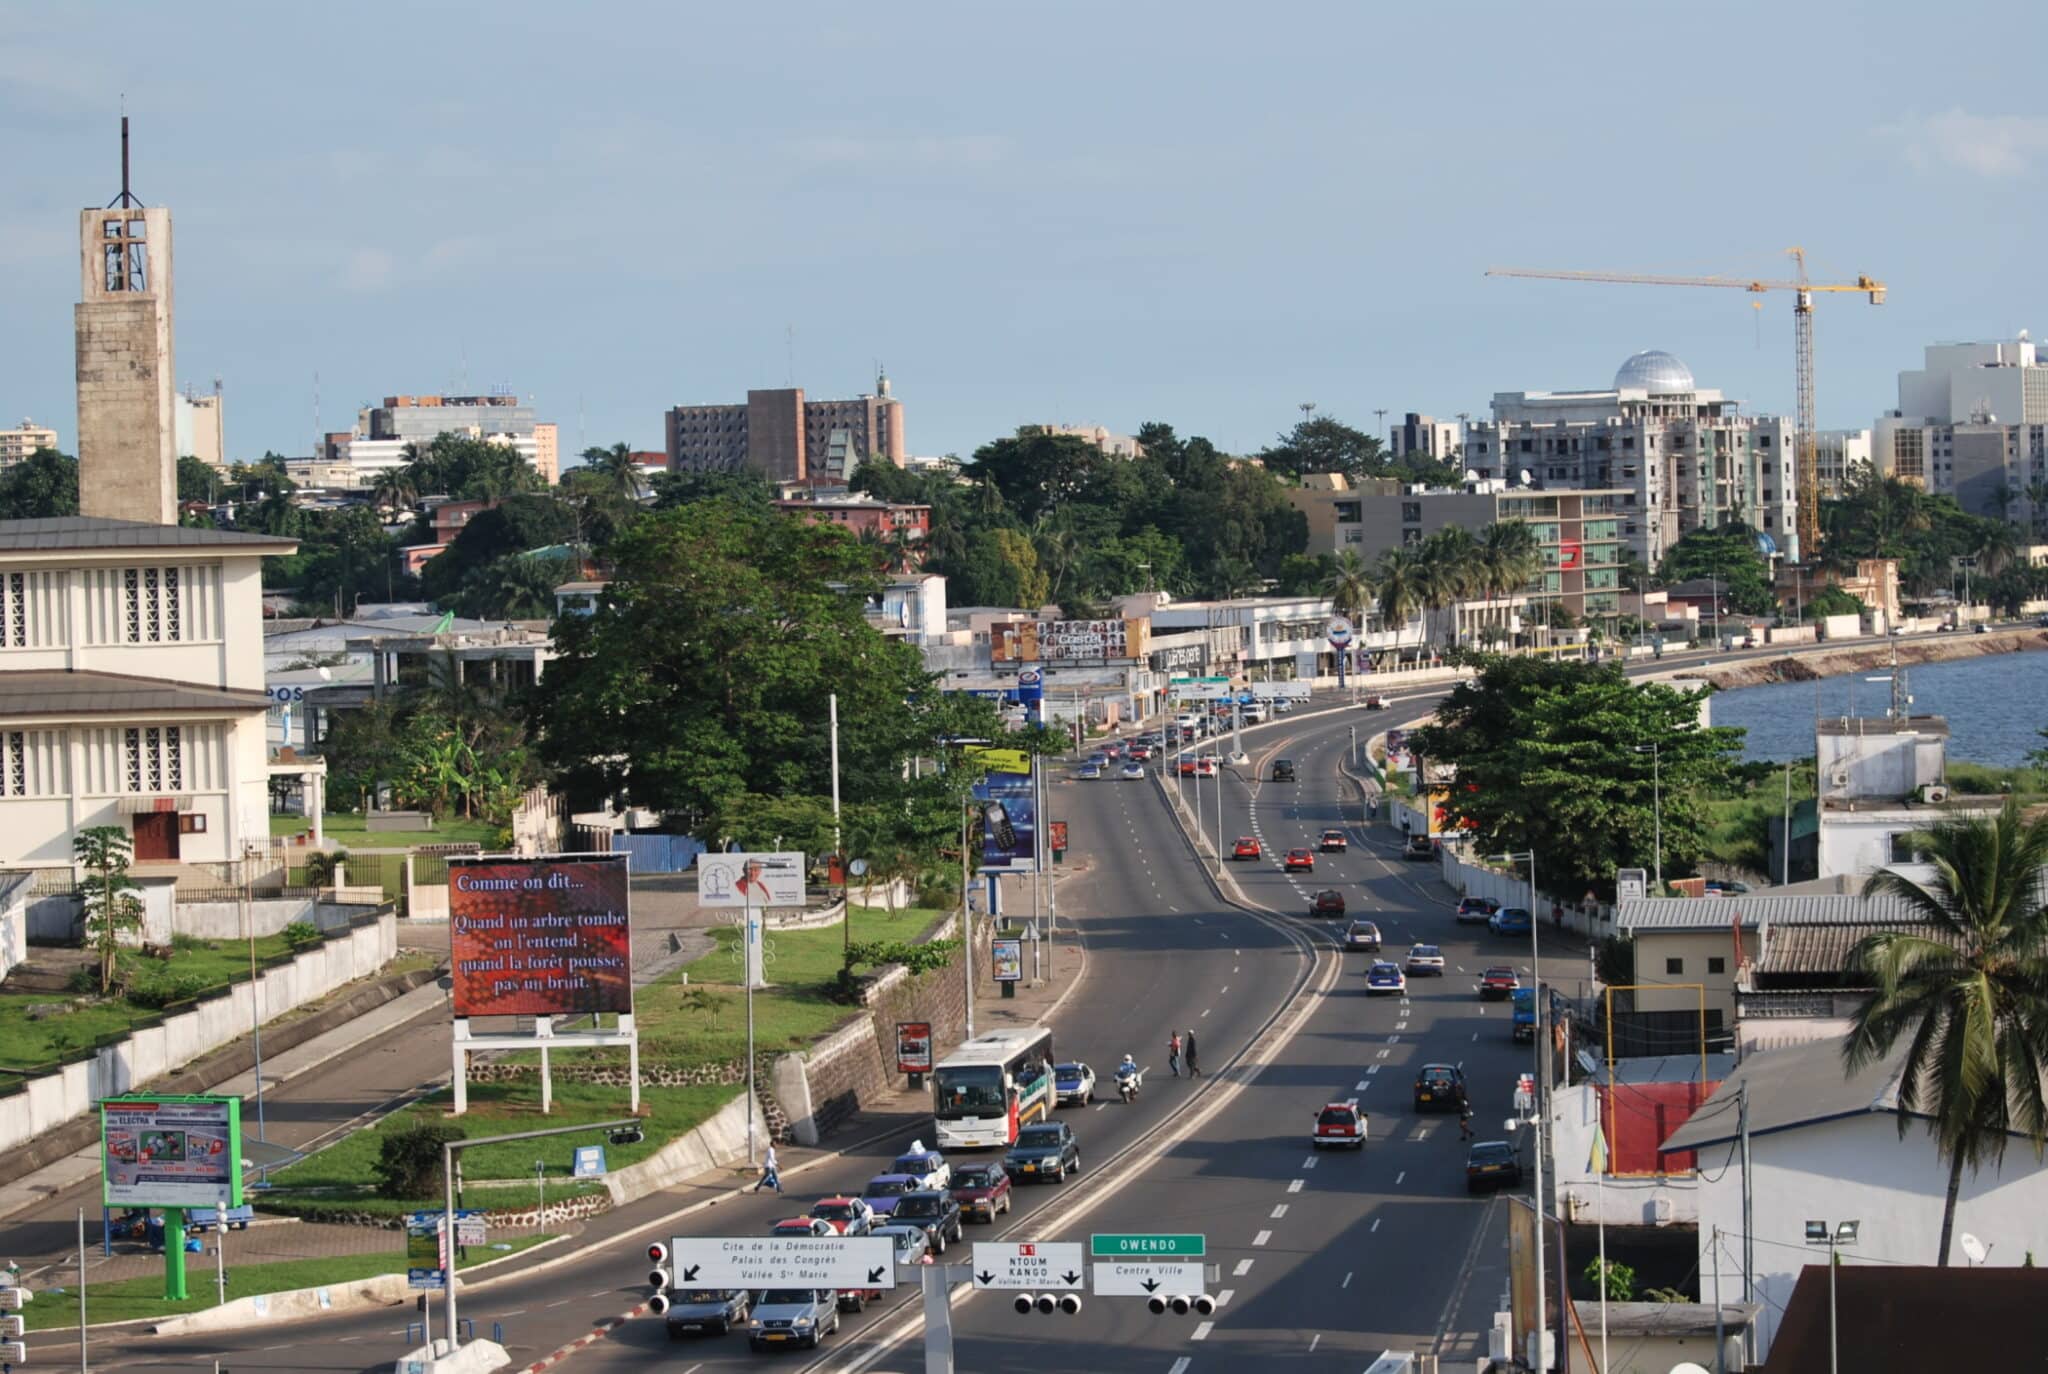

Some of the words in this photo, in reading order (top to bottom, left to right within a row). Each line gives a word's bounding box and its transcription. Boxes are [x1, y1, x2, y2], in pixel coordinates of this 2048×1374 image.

[457, 874, 518, 891] Comme
[523, 877, 543, 890] on
[548, 873, 584, 889] dit...
[454, 913, 504, 934] Quand
[509, 917, 528, 928] un
[532, 912, 573, 927] arbre
[577, 911, 626, 926] tombe
[494, 938, 513, 950] on
[517, 932, 578, 948] l'entend
[458, 956, 504, 975] quand
[509, 955, 523, 969] la
[527, 954, 563, 969] forêt
[494, 979, 519, 995] pas
[524, 979, 543, 991] un
[751, 1242, 763, 1251] de
[770, 1242, 780, 1251] la
[786, 1241, 845, 1251] Démocratie
[1120, 1239, 1176, 1250] OWENDO
[731, 1255, 763, 1265] Palais
[770, 1256, 787, 1265] des
[1009, 1258, 1047, 1266] NTOUM
[800, 1269, 828, 1279] Marie
[1009, 1268, 1048, 1276] KANGO
[1116, 1266, 1150, 1275] Centre
[1158, 1266, 1183, 1275] Ville
